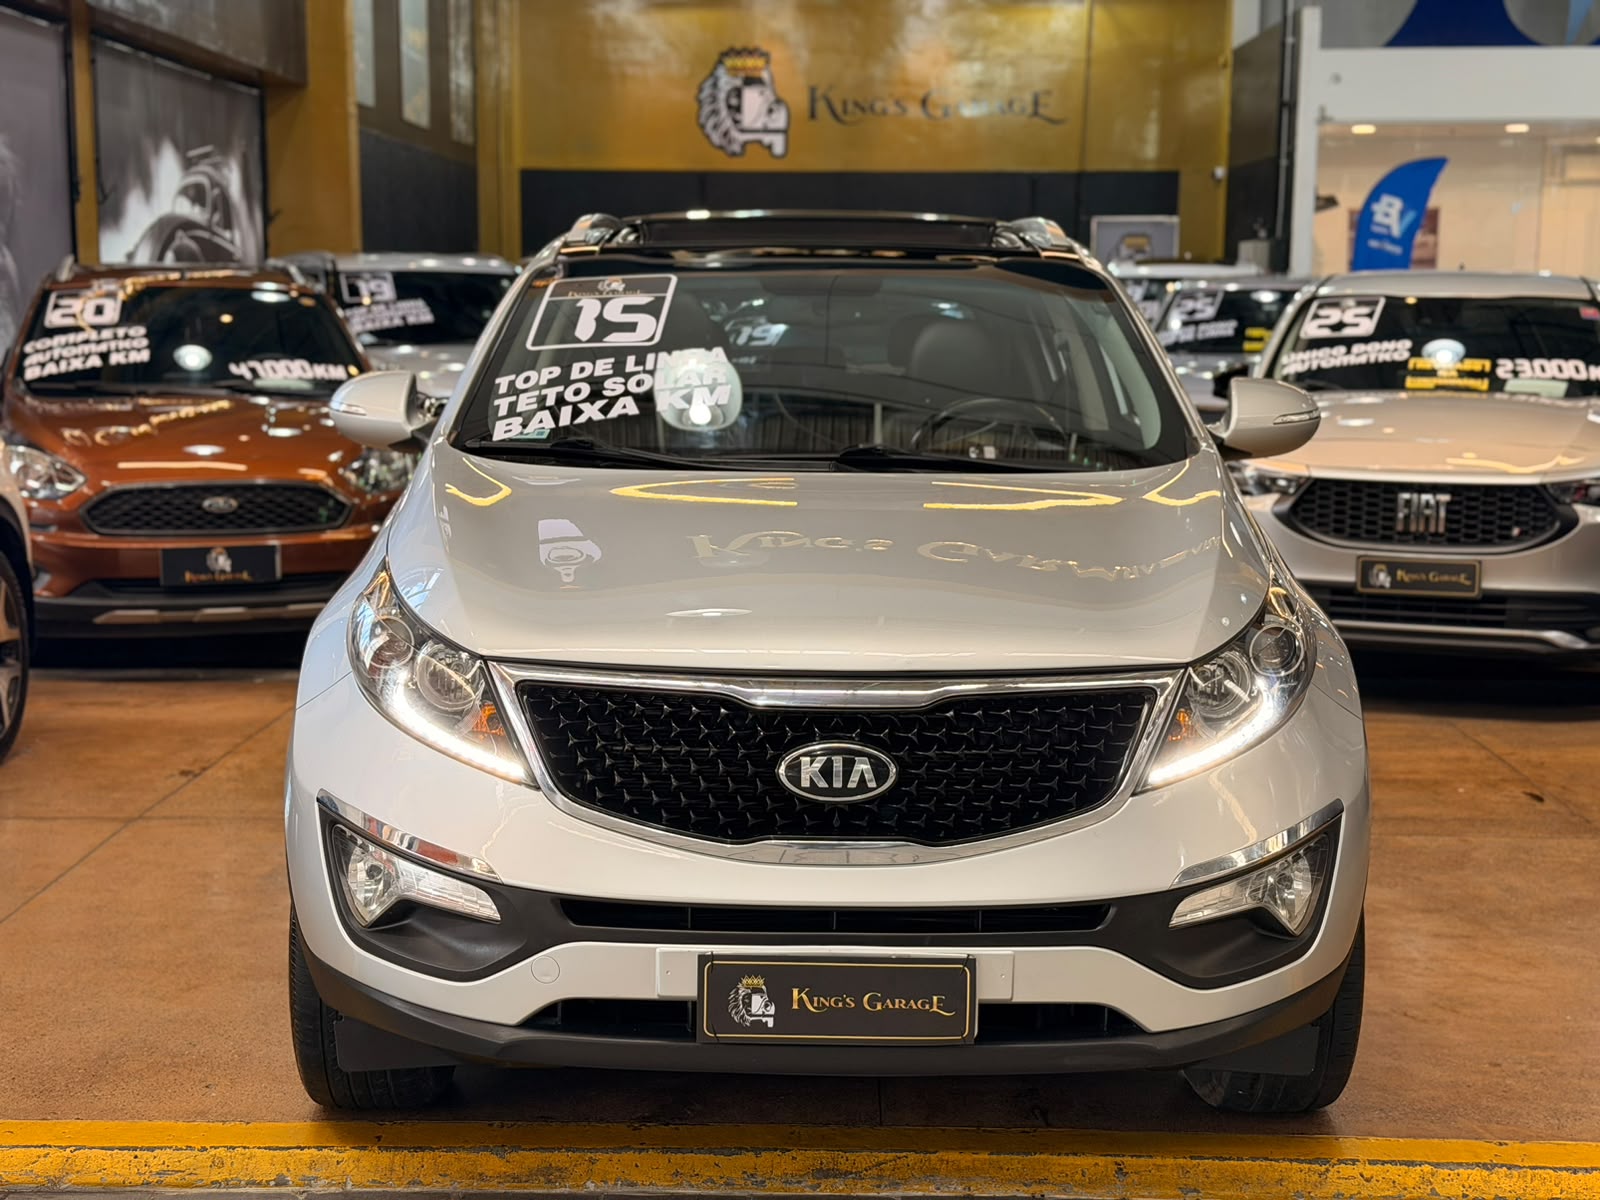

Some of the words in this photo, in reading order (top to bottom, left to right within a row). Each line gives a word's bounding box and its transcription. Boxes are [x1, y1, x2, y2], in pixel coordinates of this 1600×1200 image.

[49, 297, 117, 327] 20
[574, 297, 657, 343] 15
[1304, 306, 1374, 337] 25
[24, 353, 104, 382] BAIXA
[108, 348, 151, 367] KM
[494, 365, 562, 396] TOP
[569, 357, 616, 381] DE
[625, 346, 729, 373] LINA
[493, 381, 591, 417] TETO
[601, 363, 728, 397] SOLAR
[492, 396, 641, 442] BAIXA
[656, 384, 732, 412] KM
[1396, 492, 1452, 533] FIAT
[799, 755, 878, 789] KIA
[791, 987, 856, 1013] KING'S
[862, 992, 956, 1016] GARAGE
